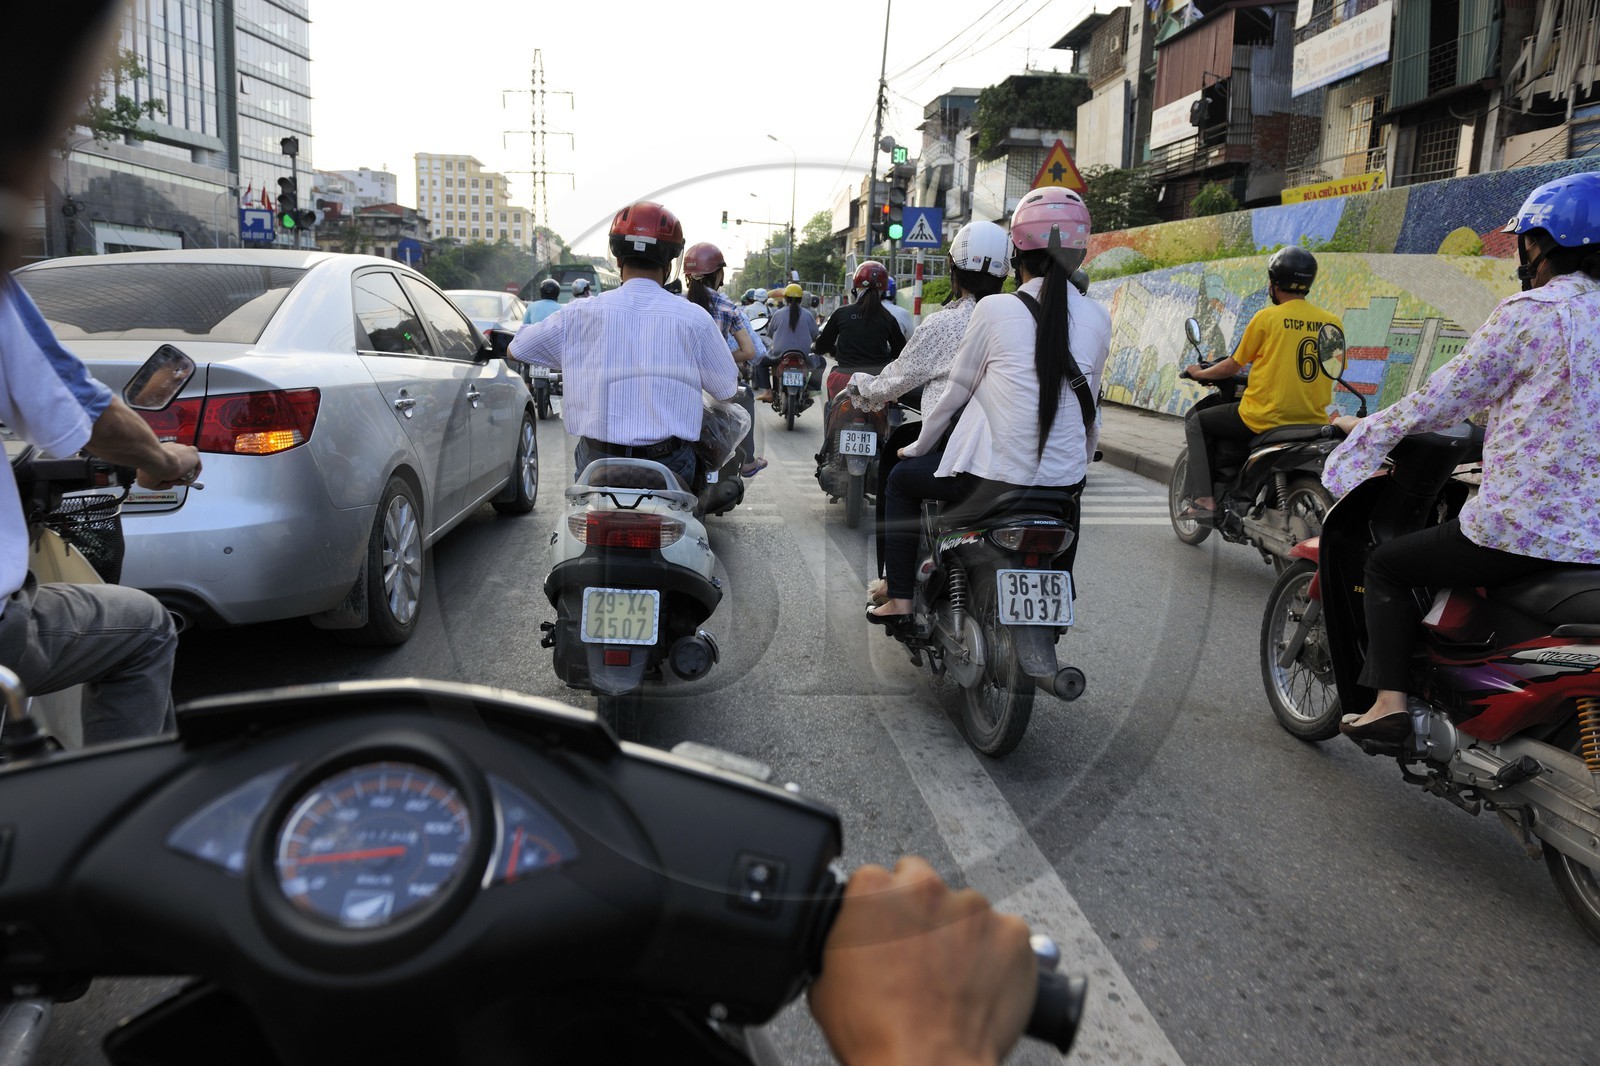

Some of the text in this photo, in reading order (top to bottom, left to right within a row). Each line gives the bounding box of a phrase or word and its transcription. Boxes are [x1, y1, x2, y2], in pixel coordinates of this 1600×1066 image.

[894, 148, 906, 163] 30
[1340, 185, 1349, 195] XE
[1351, 180, 1368, 192] MÁY
[1283, 318, 1323, 332] CTCP KIM
[1296, 336, 1319, 383] 6
[846, 432, 871, 443] 30-H1
[845, 443, 871, 453] 6406
[1008, 573, 1061, 596] 36-K6
[594, 592, 647, 615] 29-X4
[1009, 597, 1062, 621] 4037
[593, 616, 647, 640] 2507
